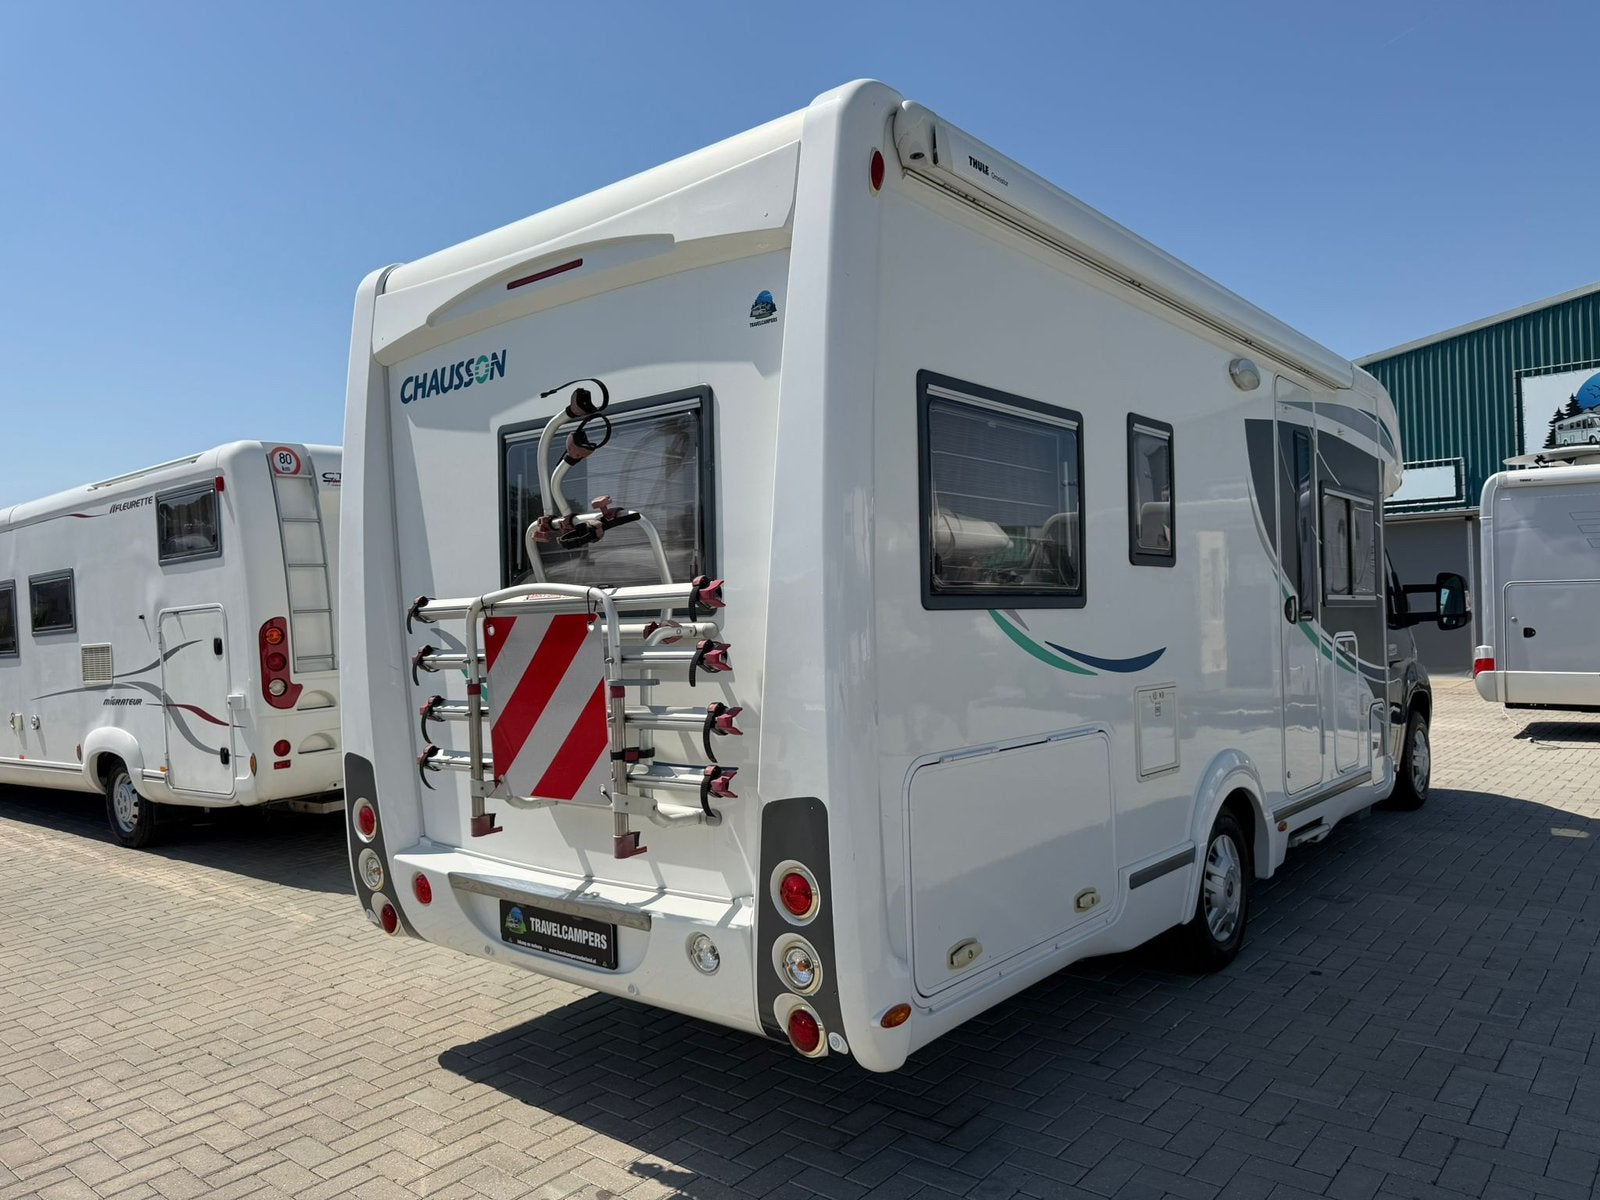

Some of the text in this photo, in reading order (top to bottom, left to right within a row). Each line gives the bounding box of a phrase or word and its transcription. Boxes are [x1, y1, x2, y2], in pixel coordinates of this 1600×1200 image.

[968, 155, 989, 176] THULE
[400, 349, 507, 404] CHAUSSON
[279, 452, 292, 465] 80
[529, 916, 608, 950] TRAVELCAMPERS
